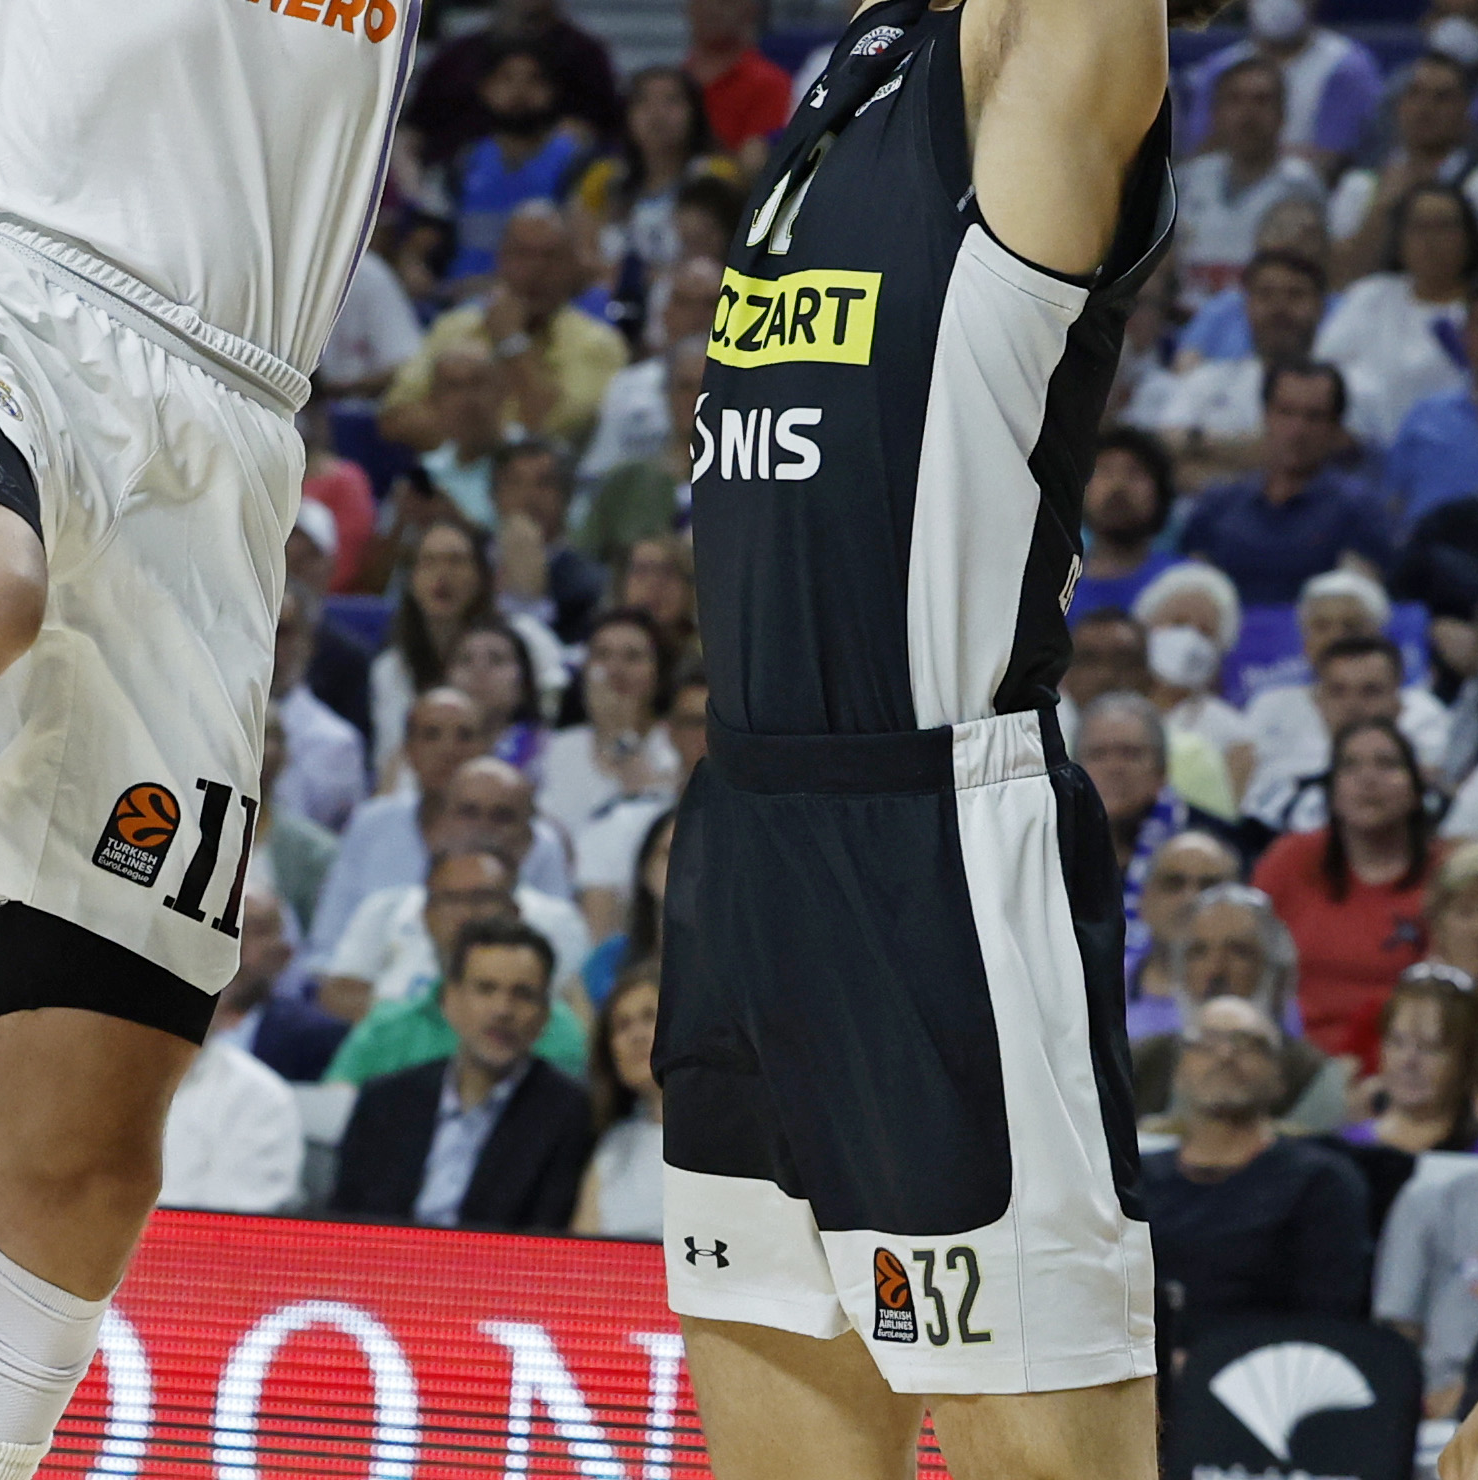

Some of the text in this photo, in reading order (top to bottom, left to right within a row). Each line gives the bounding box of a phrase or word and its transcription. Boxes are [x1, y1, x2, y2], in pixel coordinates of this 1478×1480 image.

[721, 407, 823, 481] NIS
[101, 847, 154, 875] AIRLINES
[107, 837, 159, 866] TURKISH
[163, 777, 259, 939] 11
[911, 1245, 993, 1347] 32
